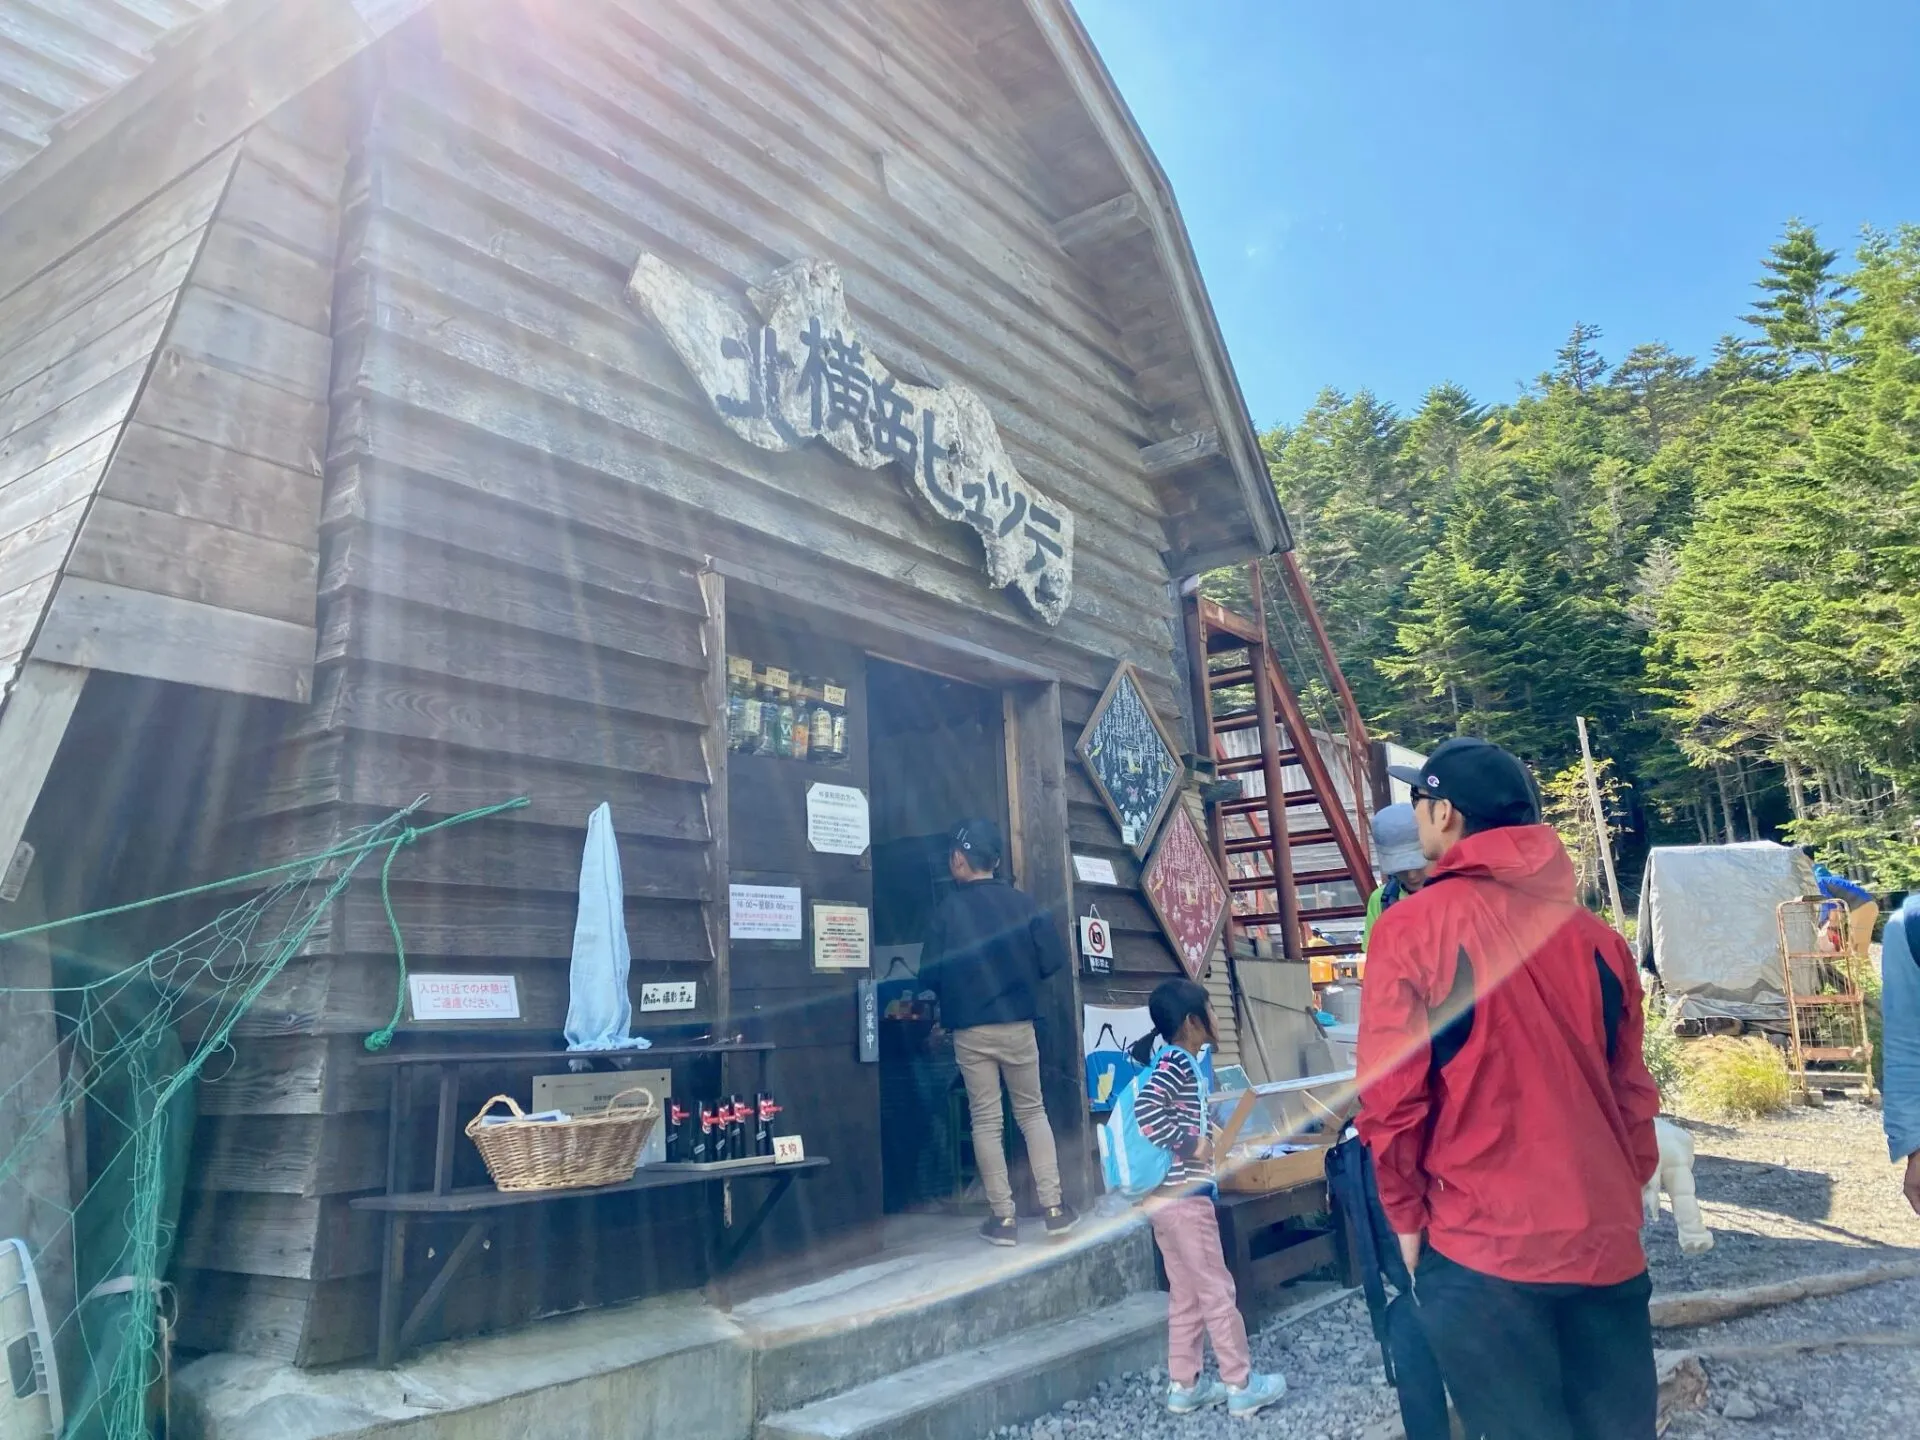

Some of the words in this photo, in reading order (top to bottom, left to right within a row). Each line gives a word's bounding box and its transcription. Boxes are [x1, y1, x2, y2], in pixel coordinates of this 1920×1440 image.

[420, 983, 509, 994] 入口付近での休憩は
[865, 992, 875, 1050] 営業中
